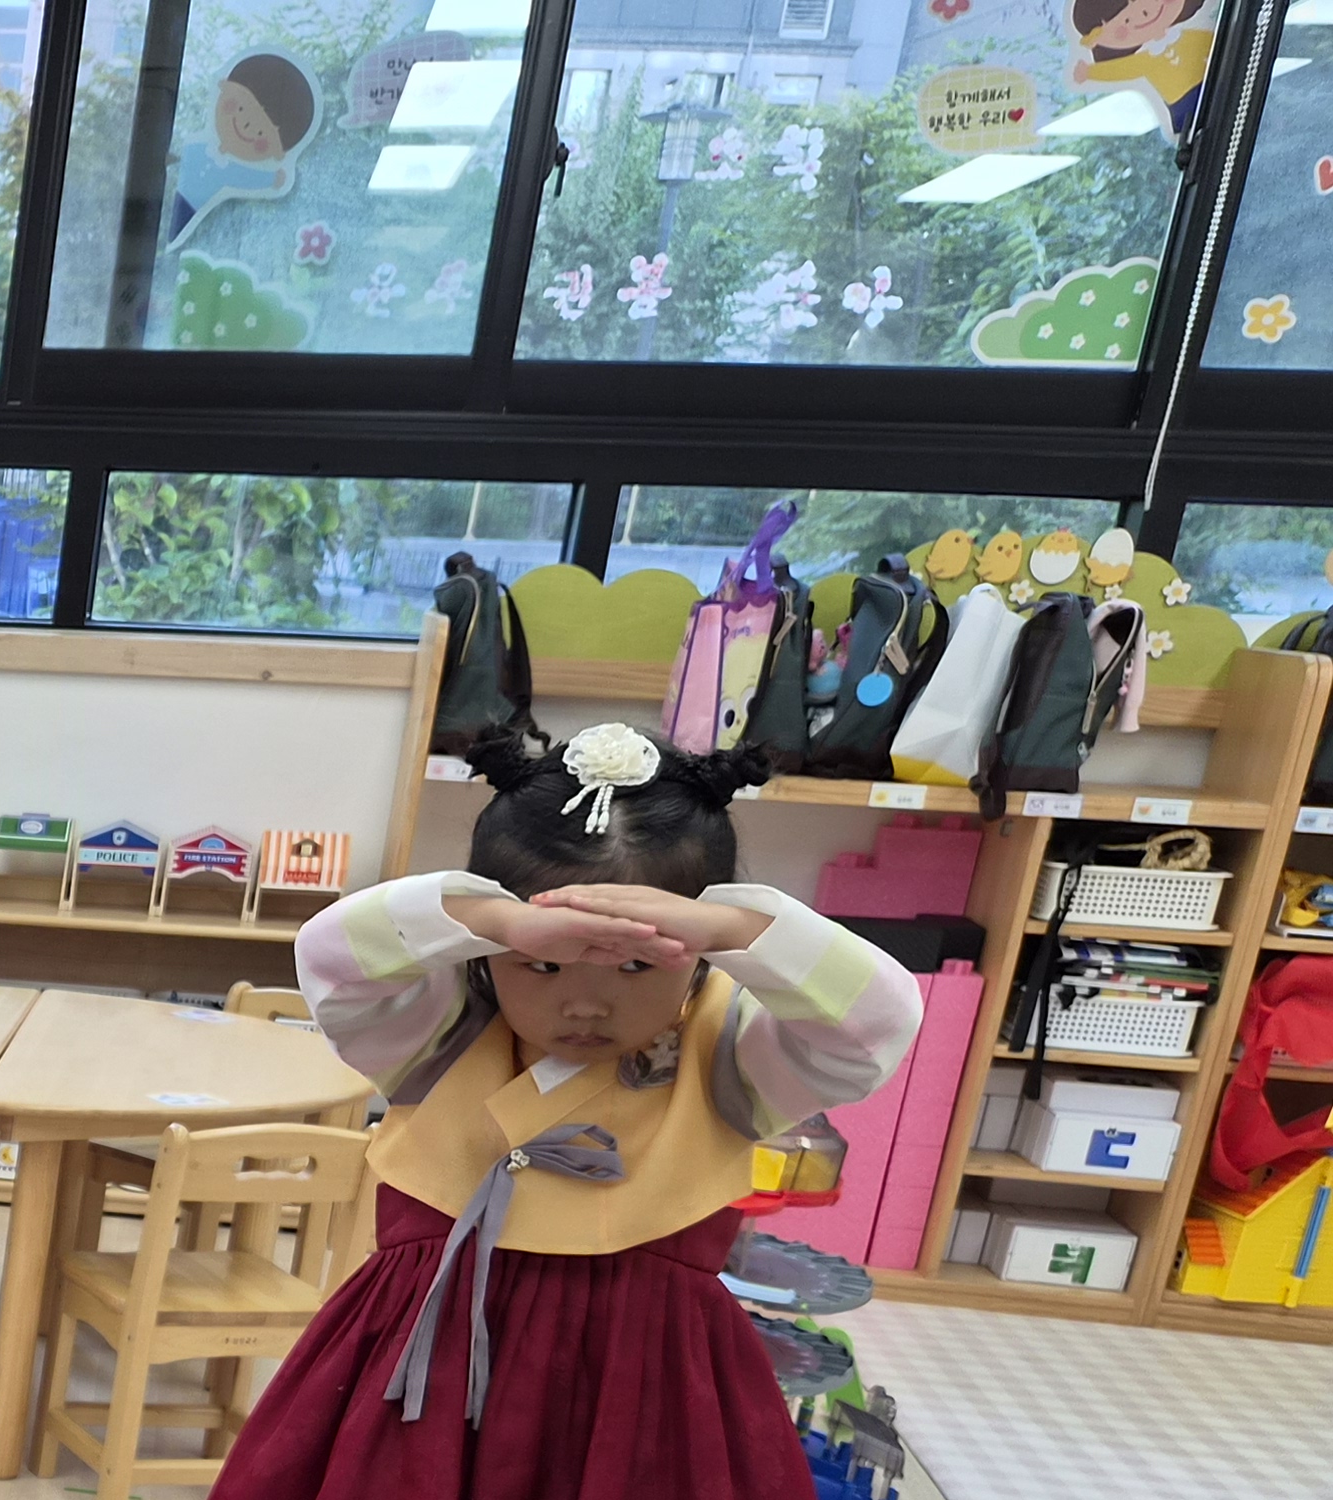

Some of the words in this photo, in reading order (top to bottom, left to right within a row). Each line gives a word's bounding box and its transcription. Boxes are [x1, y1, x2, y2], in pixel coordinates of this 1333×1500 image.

[946, 86, 1011, 109] 함께해서
[929, 111, 971, 133] 행복한
[979, 110, 1006, 127] 우리
[96, 852, 139, 863] POLICE
[202, 854, 237, 864] STATION
